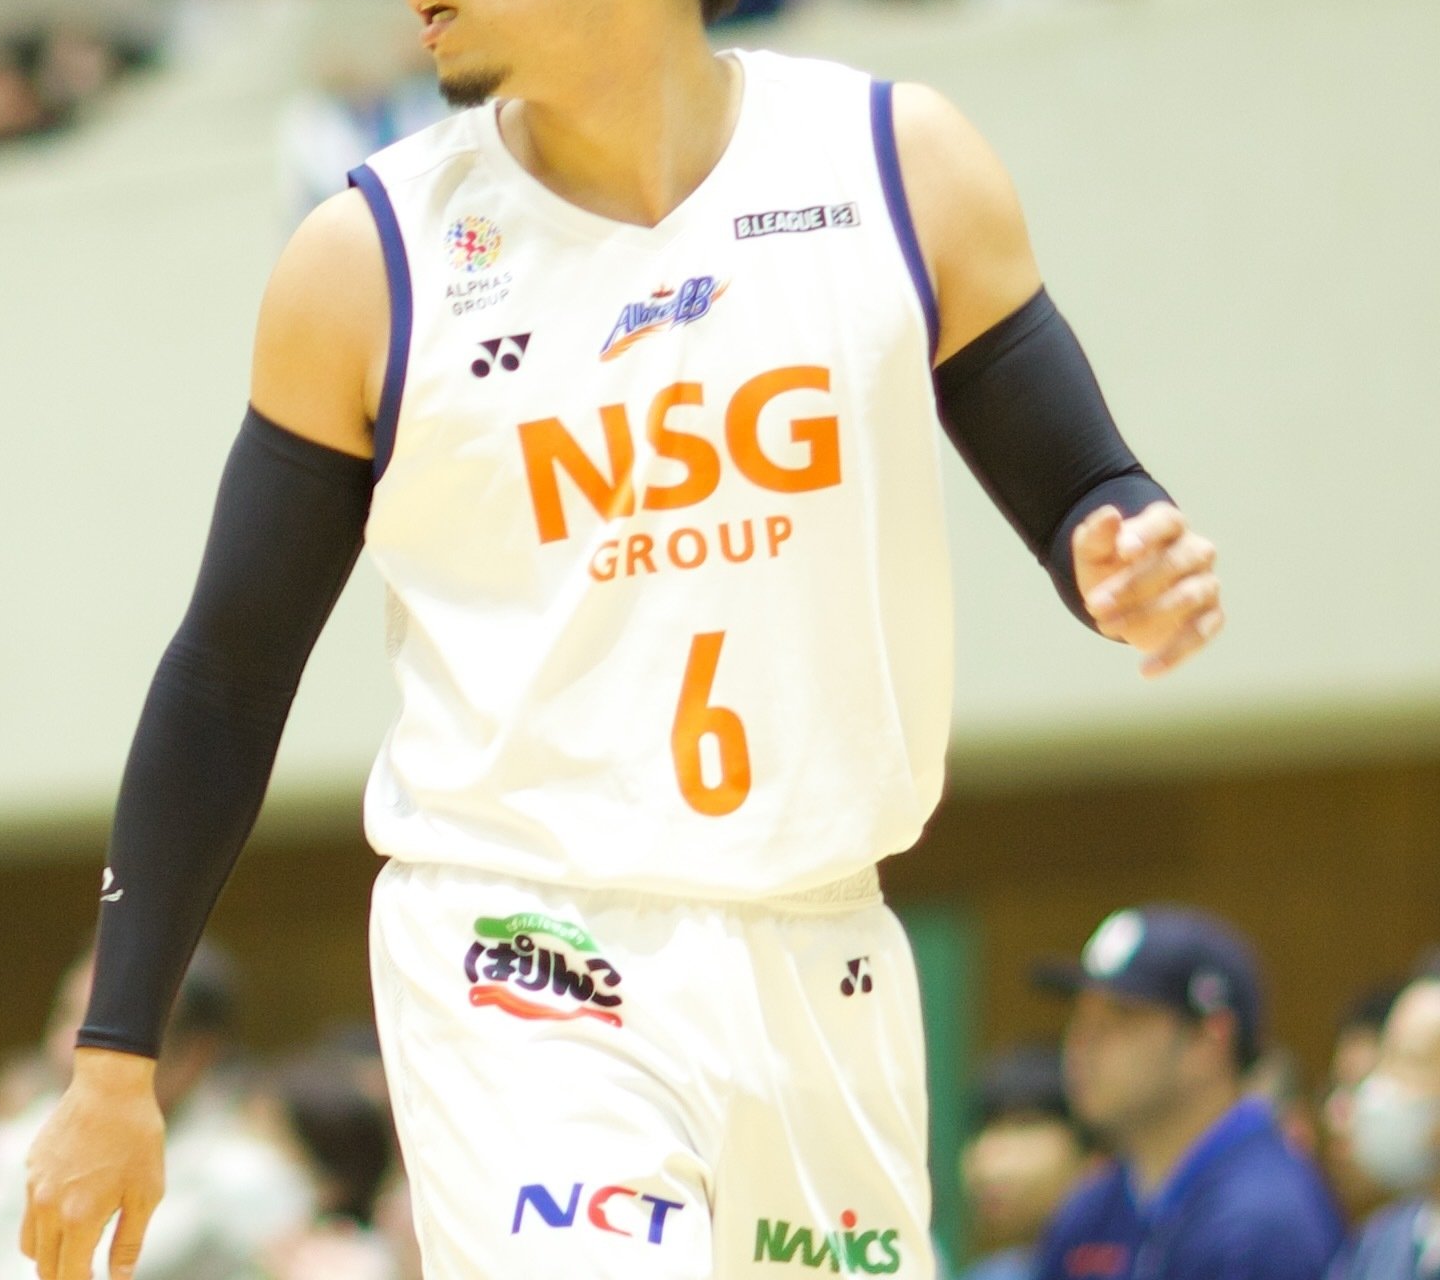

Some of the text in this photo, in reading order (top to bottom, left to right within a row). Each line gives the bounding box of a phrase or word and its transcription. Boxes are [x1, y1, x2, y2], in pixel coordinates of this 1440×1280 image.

[735, 207, 824, 239] B.LEAGUE
[445, 270, 513, 300] ALPHAS
[452, 288, 509, 317] GROUP
[516, 365, 843, 546] NSG
[587, 514, 794, 583] GROUP
[670, 630, 752, 819] 6
[464, 934, 623, 1008] ぱりんこ
[511, 1183, 686, 1245] NCT
